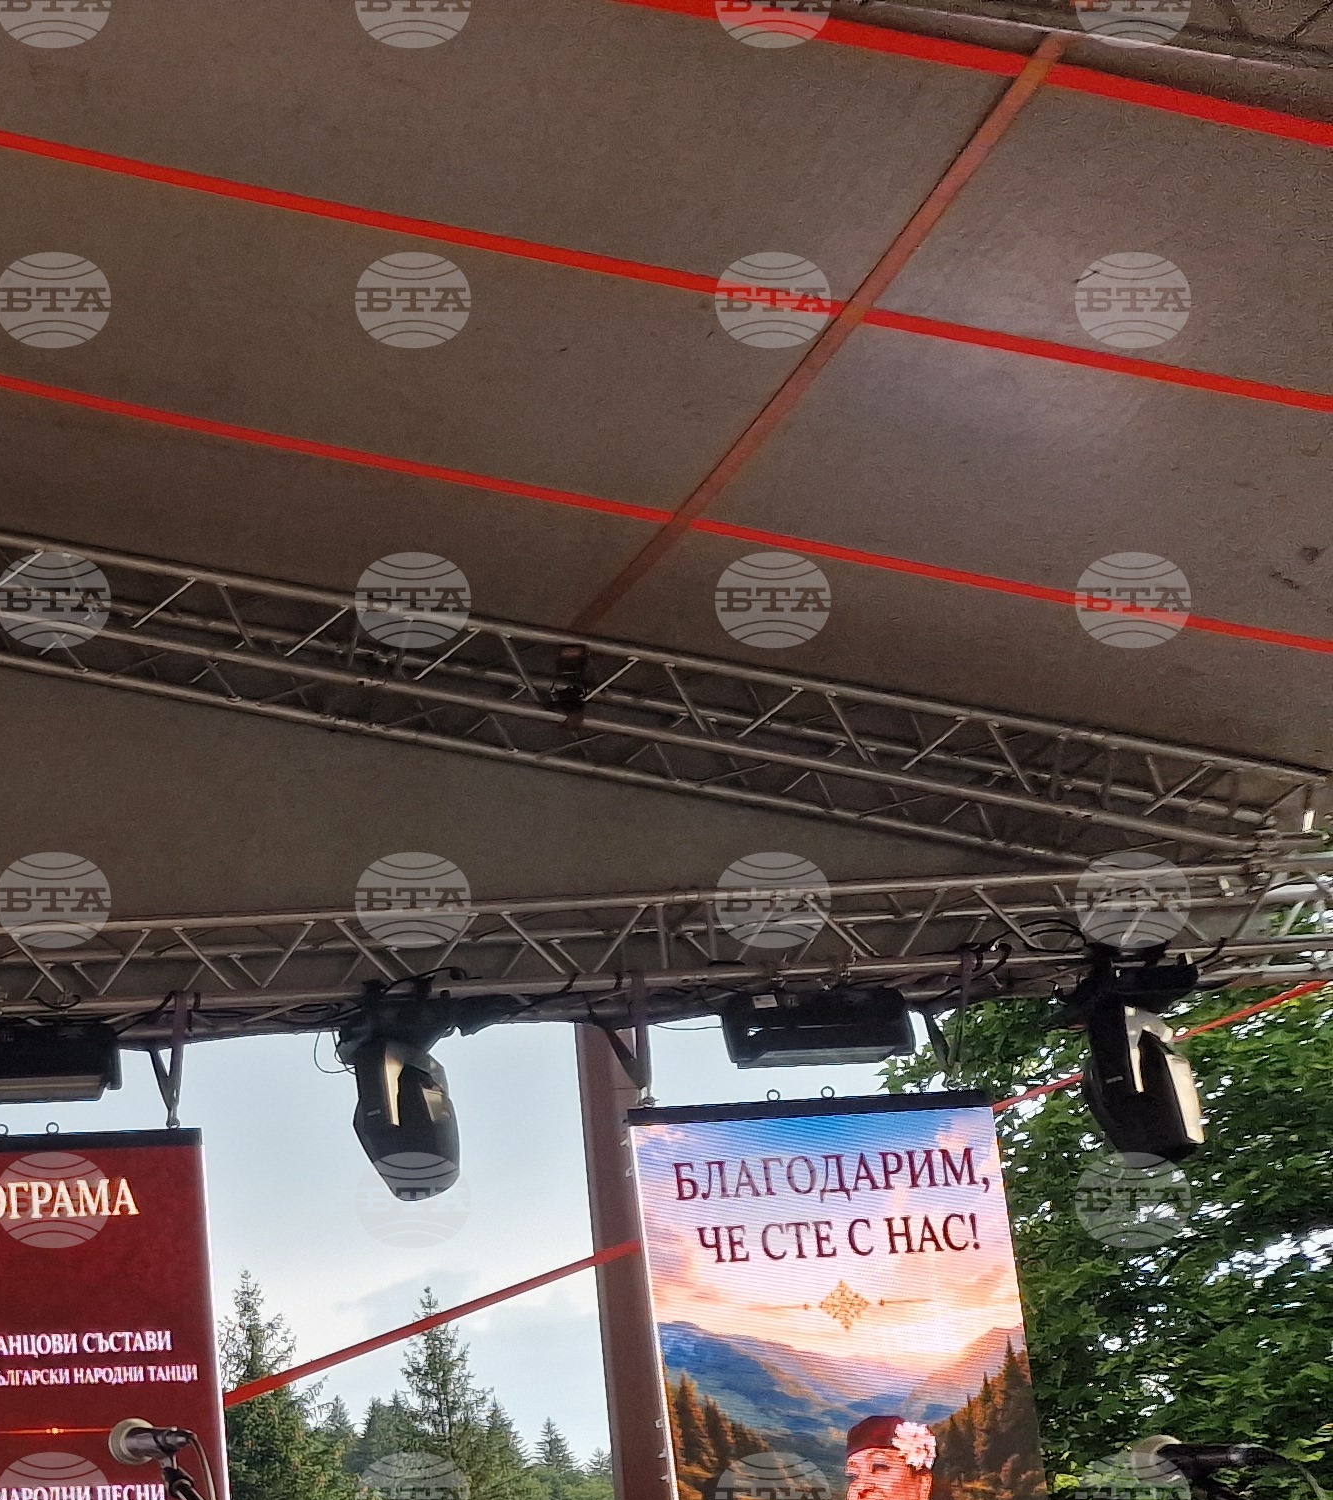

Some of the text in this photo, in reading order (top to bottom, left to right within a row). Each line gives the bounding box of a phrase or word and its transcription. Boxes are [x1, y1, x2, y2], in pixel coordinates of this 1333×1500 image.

[672, 1146, 991, 1203] БЛАГОДАРИМ,
[696, 1212, 982, 1264] ЧЕ СТЕ С НАС!
[82, 1329, 173, 1354] СЪСТАВИ
[73, 1365, 144, 1386] НАРОДНИ
[147, 1364, 199, 1384] ТАНЦИ
